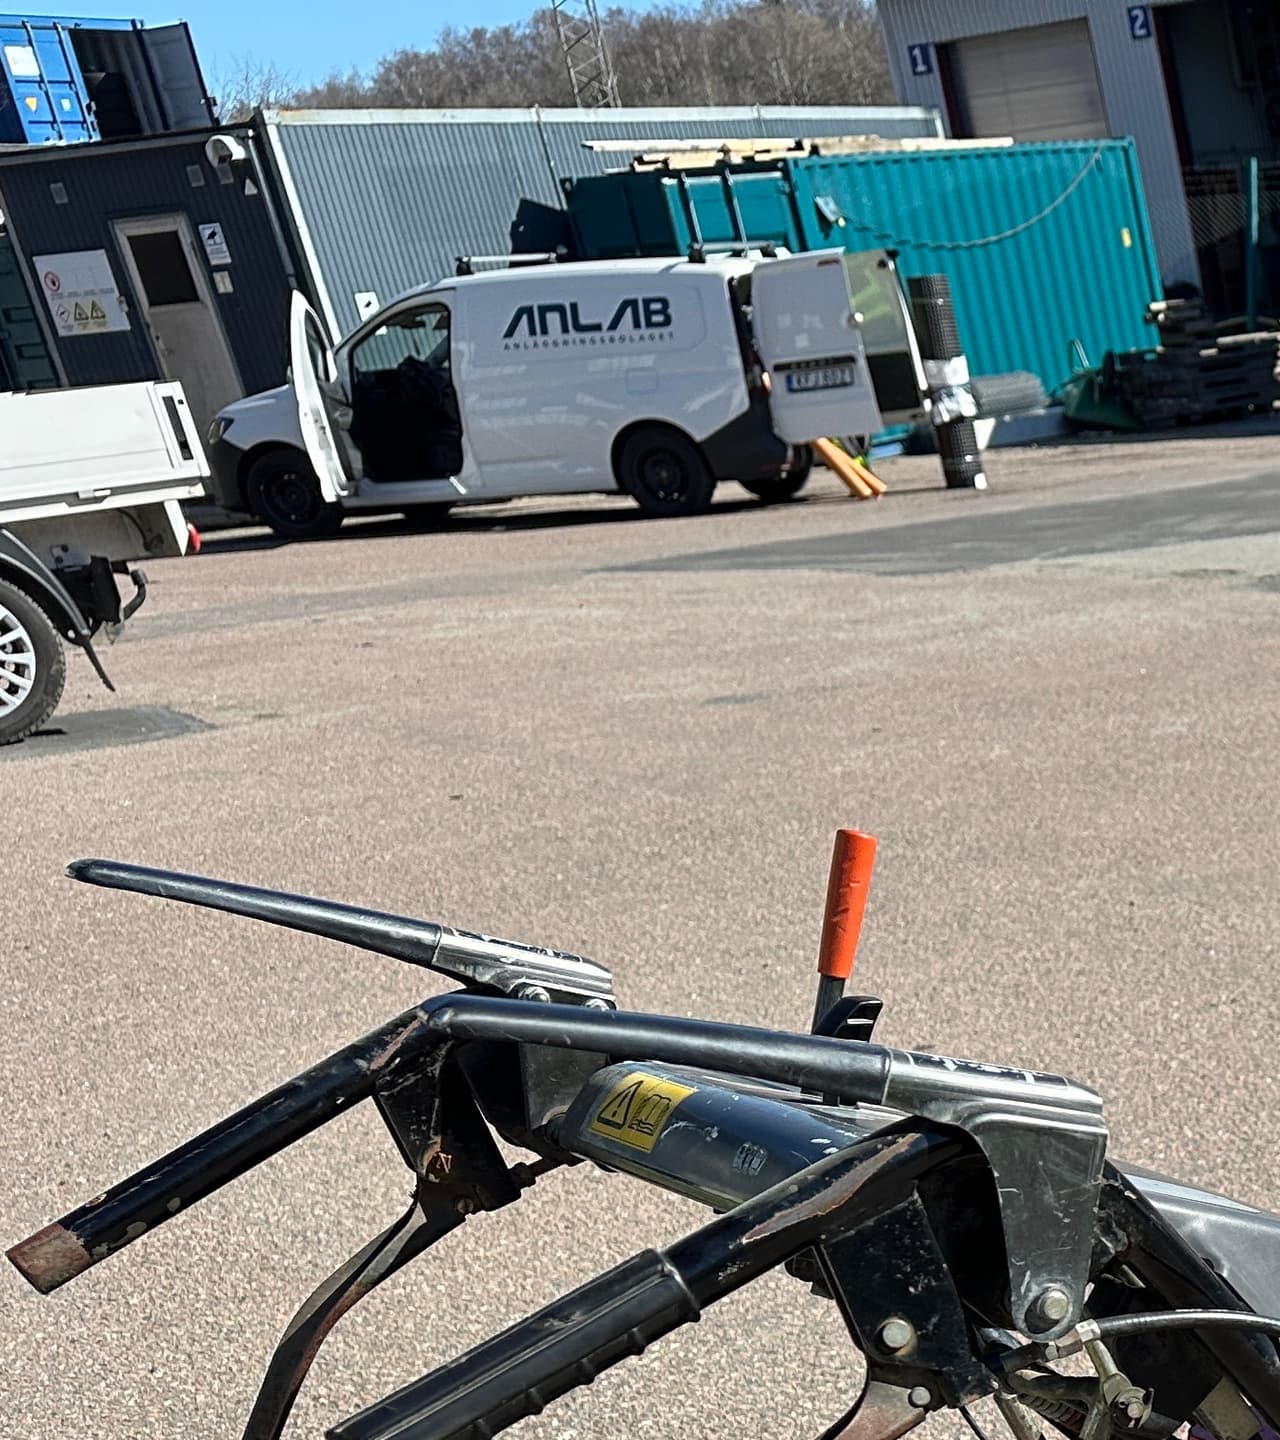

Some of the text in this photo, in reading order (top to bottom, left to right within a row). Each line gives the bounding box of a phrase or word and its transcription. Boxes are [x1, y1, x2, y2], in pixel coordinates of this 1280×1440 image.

[1130, 8, 1147, 36] 2
[911, 47, 928, 73] 1
[503, 296, 673, 338] ANLAB
